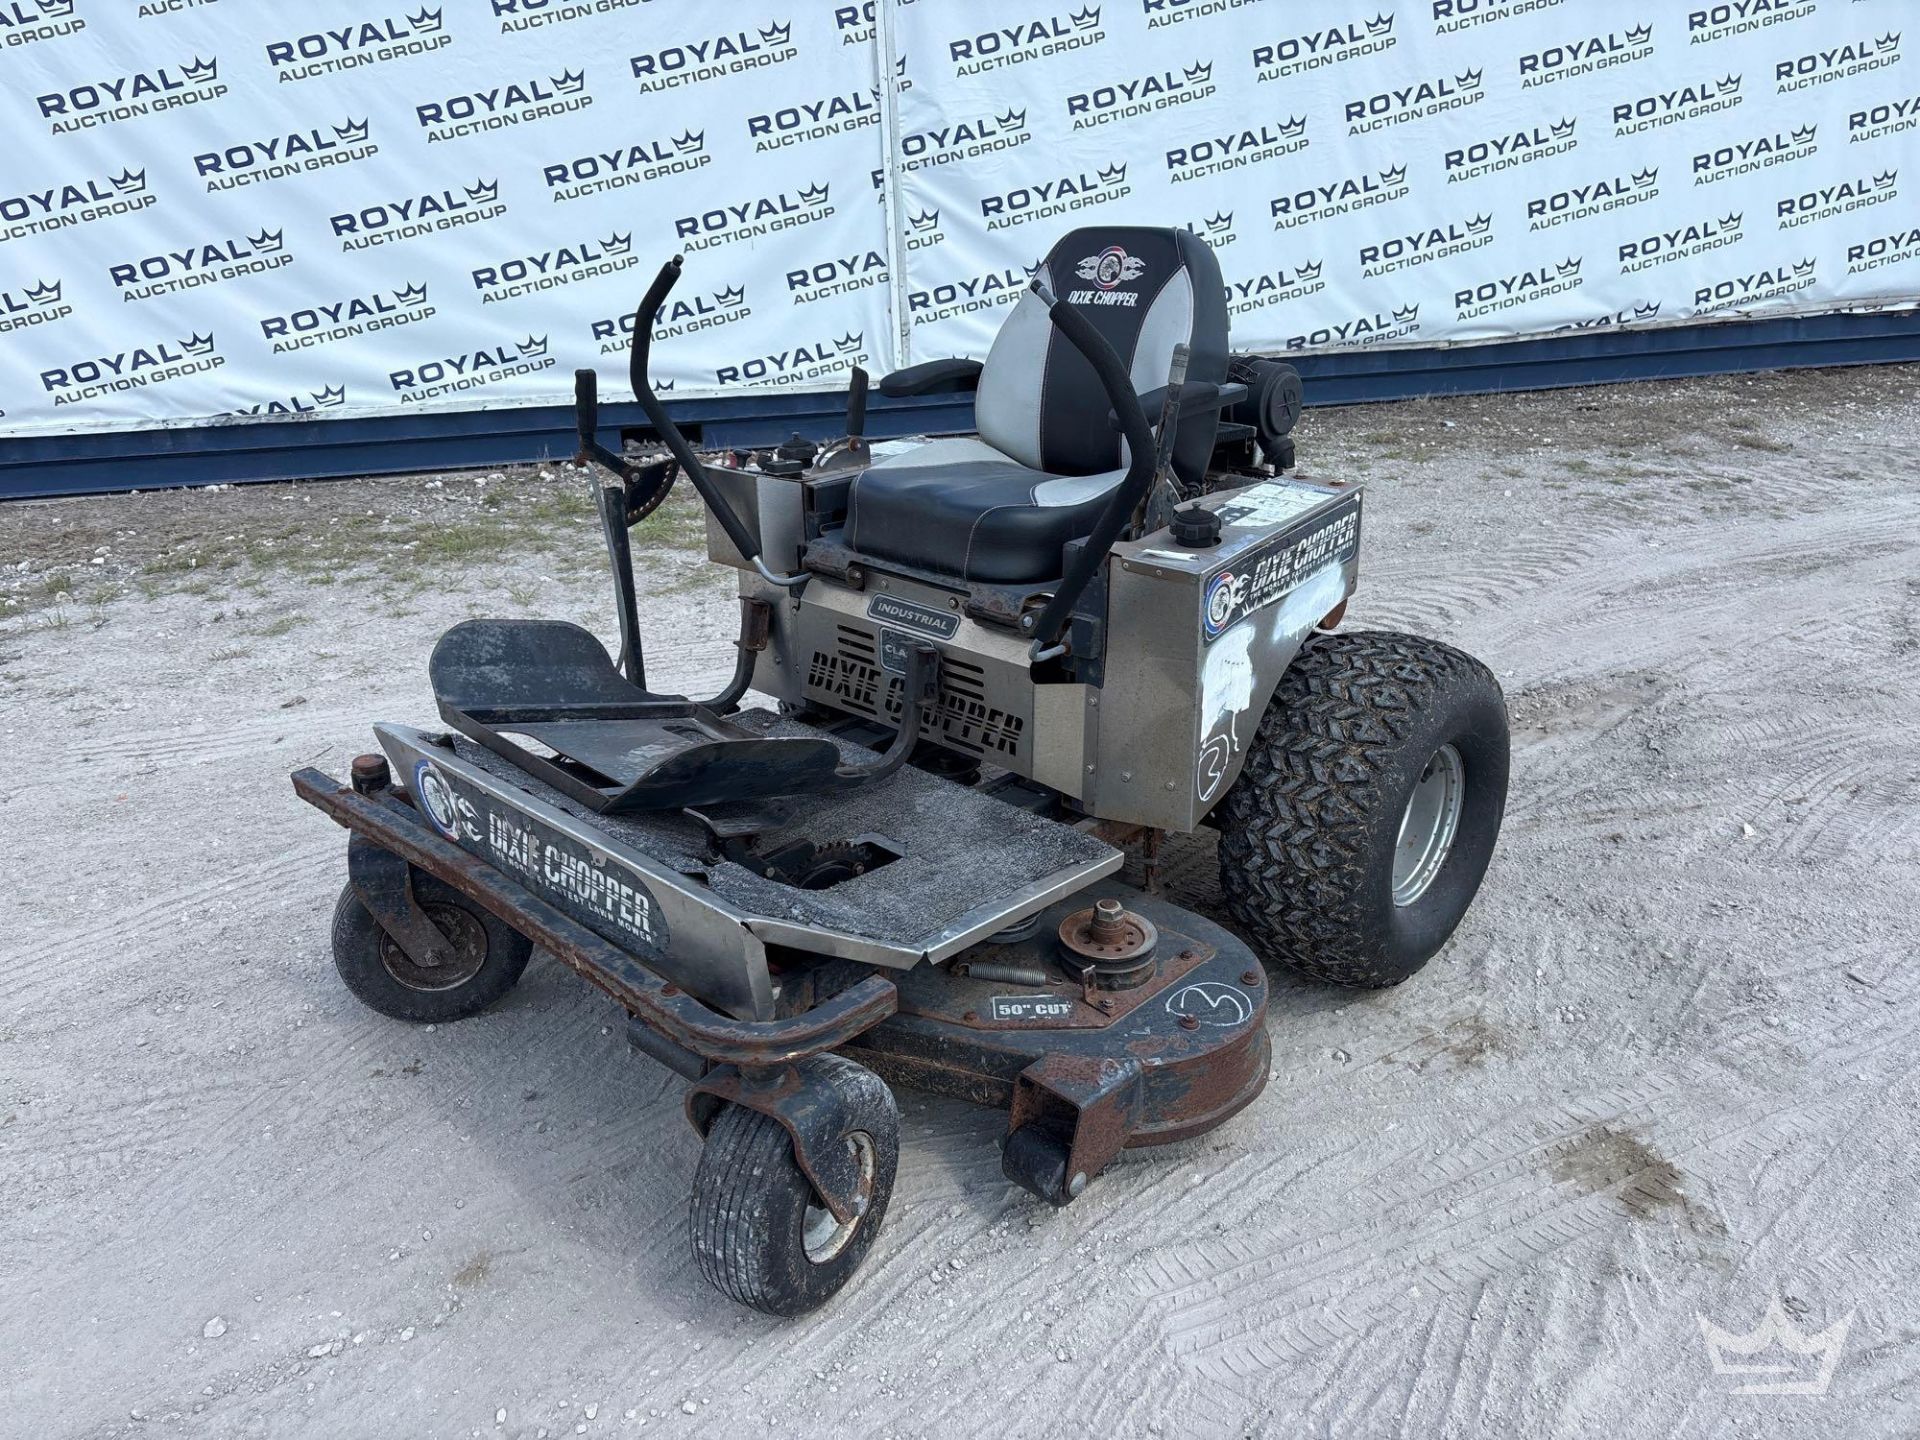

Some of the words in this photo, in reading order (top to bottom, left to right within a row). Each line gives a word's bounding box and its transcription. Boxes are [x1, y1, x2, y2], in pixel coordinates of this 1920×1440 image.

[6, 20, 86, 46] GROUP
[502, 4, 592, 34] AUCTION
[1148, 0, 1226, 29] AUCTION
[1436, 8, 1509, 35] AUCTION
[1690, 20, 1759, 45] AUCTION
[1763, 5, 1815, 26] GROUP
[266, 19, 410, 66] ROYAL
[280, 52, 374, 83] AUCTION
[378, 35, 451, 61] GROUP
[630, 33, 760, 78] ROYAL
[950, 17, 1070, 62] ROYAL
[957, 48, 1038, 78] AUCTION
[1042, 32, 1105, 56] GROUP
[1253, 24, 1365, 67] ROYAL
[1258, 54, 1332, 83] AUCTION
[1337, 38, 1396, 61] GROUP
[1520, 34, 1624, 75] ROYAL
[640, 64, 726, 94] AUCTION
[730, 48, 797, 72] GROUP
[1522, 62, 1592, 89] AUCTION
[1597, 47, 1653, 69] GROUP
[1776, 42, 1873, 81] ROYAL
[1777, 69, 1844, 94] AUCTION
[1847, 54, 1900, 76] GROUP
[36, 69, 184, 118] ROYAL
[53, 103, 148, 135] AUCTION
[152, 85, 227, 111] GROUP
[416, 81, 553, 127] ROYAL
[748, 92, 872, 137] ROYAL
[1067, 72, 1183, 115] ROYAL
[1074, 102, 1151, 131] AUCTION
[1156, 86, 1216, 109] GROUP
[1345, 79, 1455, 122] ROYAL
[1349, 108, 1422, 136] AUCTION
[1427, 92, 1484, 115] GROUP
[1614, 84, 1715, 124] ROYAL
[428, 113, 518, 143] AUCTION
[522, 96, 592, 121] GROUP
[756, 123, 839, 153] AUCTION
[844, 112, 881, 131] GRO
[1615, 111, 1685, 137] AUCTION
[1689, 96, 1742, 117] GROUP
[1850, 118, 1916, 143] AUCTION
[194, 130, 336, 176] ROYAL
[902, 120, 996, 156] OYAL
[968, 133, 1031, 157] GROUP
[1166, 127, 1278, 169] ROYAL
[1445, 128, 1549, 170] ROYAL
[1693, 134, 1790, 173] ROYAL
[207, 162, 301, 193] AUCTION
[305, 145, 378, 170] GROUP
[544, 142, 674, 187] ROYAL
[554, 173, 640, 202] AUCTION
[644, 155, 711, 180] GROUP
[1171, 156, 1247, 184] AUCTION
[1251, 139, 1309, 162] GROUP
[1448, 156, 1518, 184] AUCTION
[1522, 140, 1577, 163] GROUP
[1695, 161, 1760, 186] AUCTION
[1764, 146, 1817, 167] GROUP
[0, 181, 114, 221] OYAL
[81, 195, 156, 221] GROUP
[330, 191, 467, 236] ROYAL
[675, 194, 800, 238] ROYAL
[981, 174, 1098, 217] ROYAL
[987, 203, 1066, 231] AUCTION
[1070, 187, 1130, 210] GROUP
[1271, 175, 1379, 217] ROYAL
[1275, 203, 1348, 231] AUCTION
[1352, 187, 1409, 210] GROUP
[1528, 178, 1630, 219] ROYAL
[1530, 205, 1599, 232] AUCTION
[1603, 189, 1658, 211] GROUP
[1778, 180, 1871, 217] ROYAL
[1779, 205, 1841, 230] AUCTION
[1846, 190, 1897, 211] GROUP
[343, 222, 433, 252] AUCTION
[436, 205, 506, 230] GROUP
[684, 224, 766, 253] AUCTION
[770, 207, 835, 231] GROUP
[1360, 224, 1464, 265] ROYAL
[1619, 222, 1717, 262] ROYAL
[1848, 229, 1920, 262] ROYA
[109, 240, 252, 287] ROYAL
[472, 244, 601, 289] ROYAL
[786, 251, 888, 290] ROYA
[1363, 252, 1433, 279] AUCTION
[1438, 235, 1493, 258] GROUP
[1621, 248, 1688, 275] AUCTION
[1692, 233, 1743, 254] GROUP
[1848, 250, 1911, 275] AUCTION
[124, 272, 217, 302] AUCTION
[221, 254, 293, 279] GROUP
[483, 274, 568, 304] AUCTION
[572, 256, 638, 281] GROUP
[794, 276, 873, 305] AUCTION
[908, 270, 1024, 311] ROYAL
[1067, 290, 1096, 304] DIXIE
[1268, 282, 1325, 304] GROUP
[1455, 268, 1555, 308] ROYAL
[1692, 293, 1762, 317] AUCTION
[1765, 278, 1816, 298] GROUP
[1695, 268, 1791, 306] ROYAL
[0, 305, 72, 332] GROUP
[260, 294, 396, 339] ROYAL
[915, 298, 992, 326] AUCTION
[1457, 294, 1525, 321] AUCTION
[1530, 278, 1582, 300] GROUP
[273, 324, 363, 354] AUCTION
[367, 307, 436, 331] GROUP
[687, 311, 751, 332] GROUP
[1287, 314, 1391, 349] ROYAL
[1363, 324, 1420, 344] GROUP
[40, 344, 183, 391] ROYAL
[55, 375, 147, 406] AUCTION
[151, 357, 225, 382] GROUP
[389, 347, 518, 390] ROYAL
[401, 375, 486, 404] AUCTION
[489, 358, 556, 381] GROUP
[716, 343, 835, 385] ROYAL
[807, 354, 868, 378] GROUP
[1294, 512, 1356, 571] CHOPPER
[877, 602, 948, 630] INDUSTRIAL
[808, 651, 881, 705] DIXIE
[544, 844, 650, 932] CHOPPER
[617, 918, 652, 944] MOWER
[999, 1004, 1030, 1015] 50"
